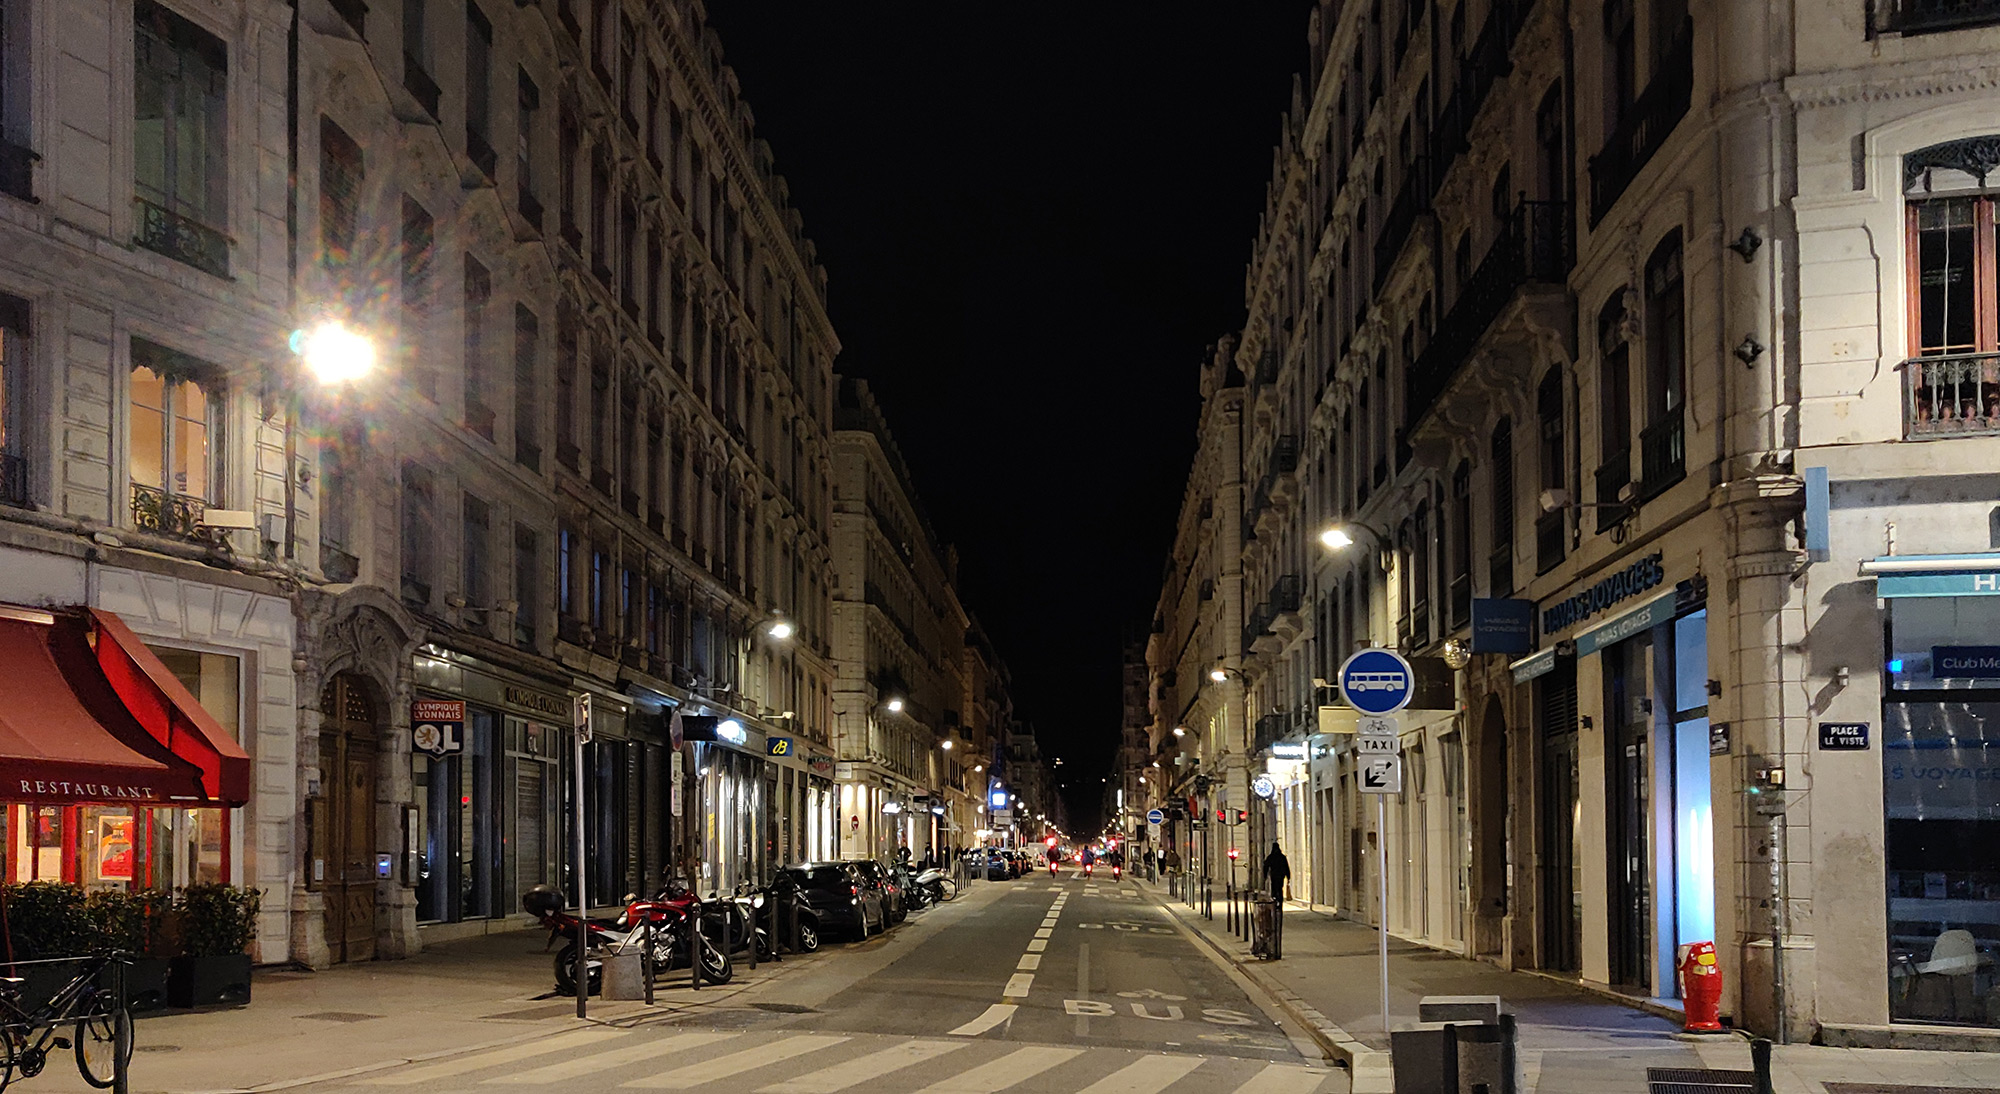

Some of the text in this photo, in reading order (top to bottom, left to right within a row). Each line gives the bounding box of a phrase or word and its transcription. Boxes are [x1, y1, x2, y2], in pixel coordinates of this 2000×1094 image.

[1974, 574, 2000, 591] H
[1543, 553, 1664, 635] HAVAS VOYAGES
[1942, 657, 1978, 669] Club
[413, 703, 461, 711] OLYMPIQUE
[414, 711, 461, 719] LYONNAIS
[1830, 726, 1859, 735] PLACE
[1364, 740, 1393, 750] TAXI
[1824, 736, 1865, 745] LE VISTE
[20, 779, 152, 799] RESTAURANT
[1079, 922, 1174, 935] BUS
[1063, 999, 1259, 1026] BUS
